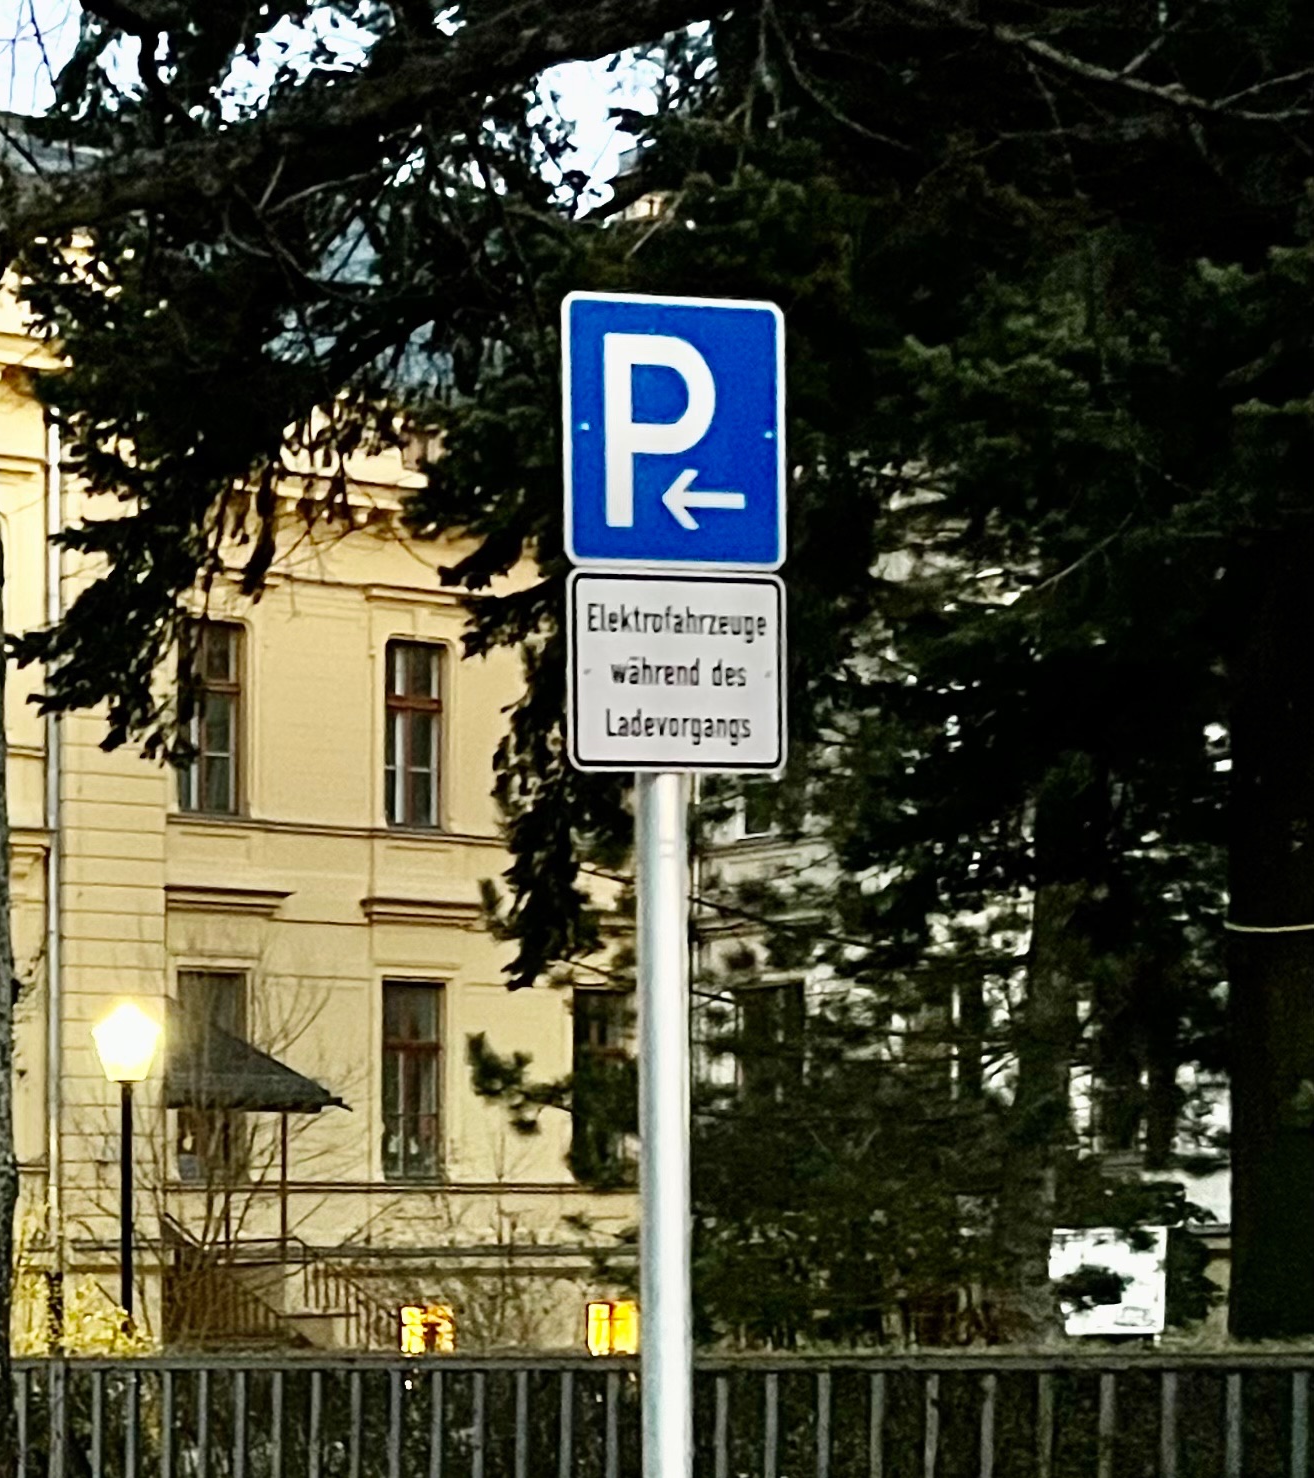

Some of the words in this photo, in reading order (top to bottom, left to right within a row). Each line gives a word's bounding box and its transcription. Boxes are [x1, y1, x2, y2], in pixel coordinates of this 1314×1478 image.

[603, 332, 717, 528] P
[587, 603, 768, 644] Elektrofahrzeuge
[610, 656, 701, 686] während
[711, 658, 747, 687] des
[605, 707, 752, 746] Ladevorgangs
